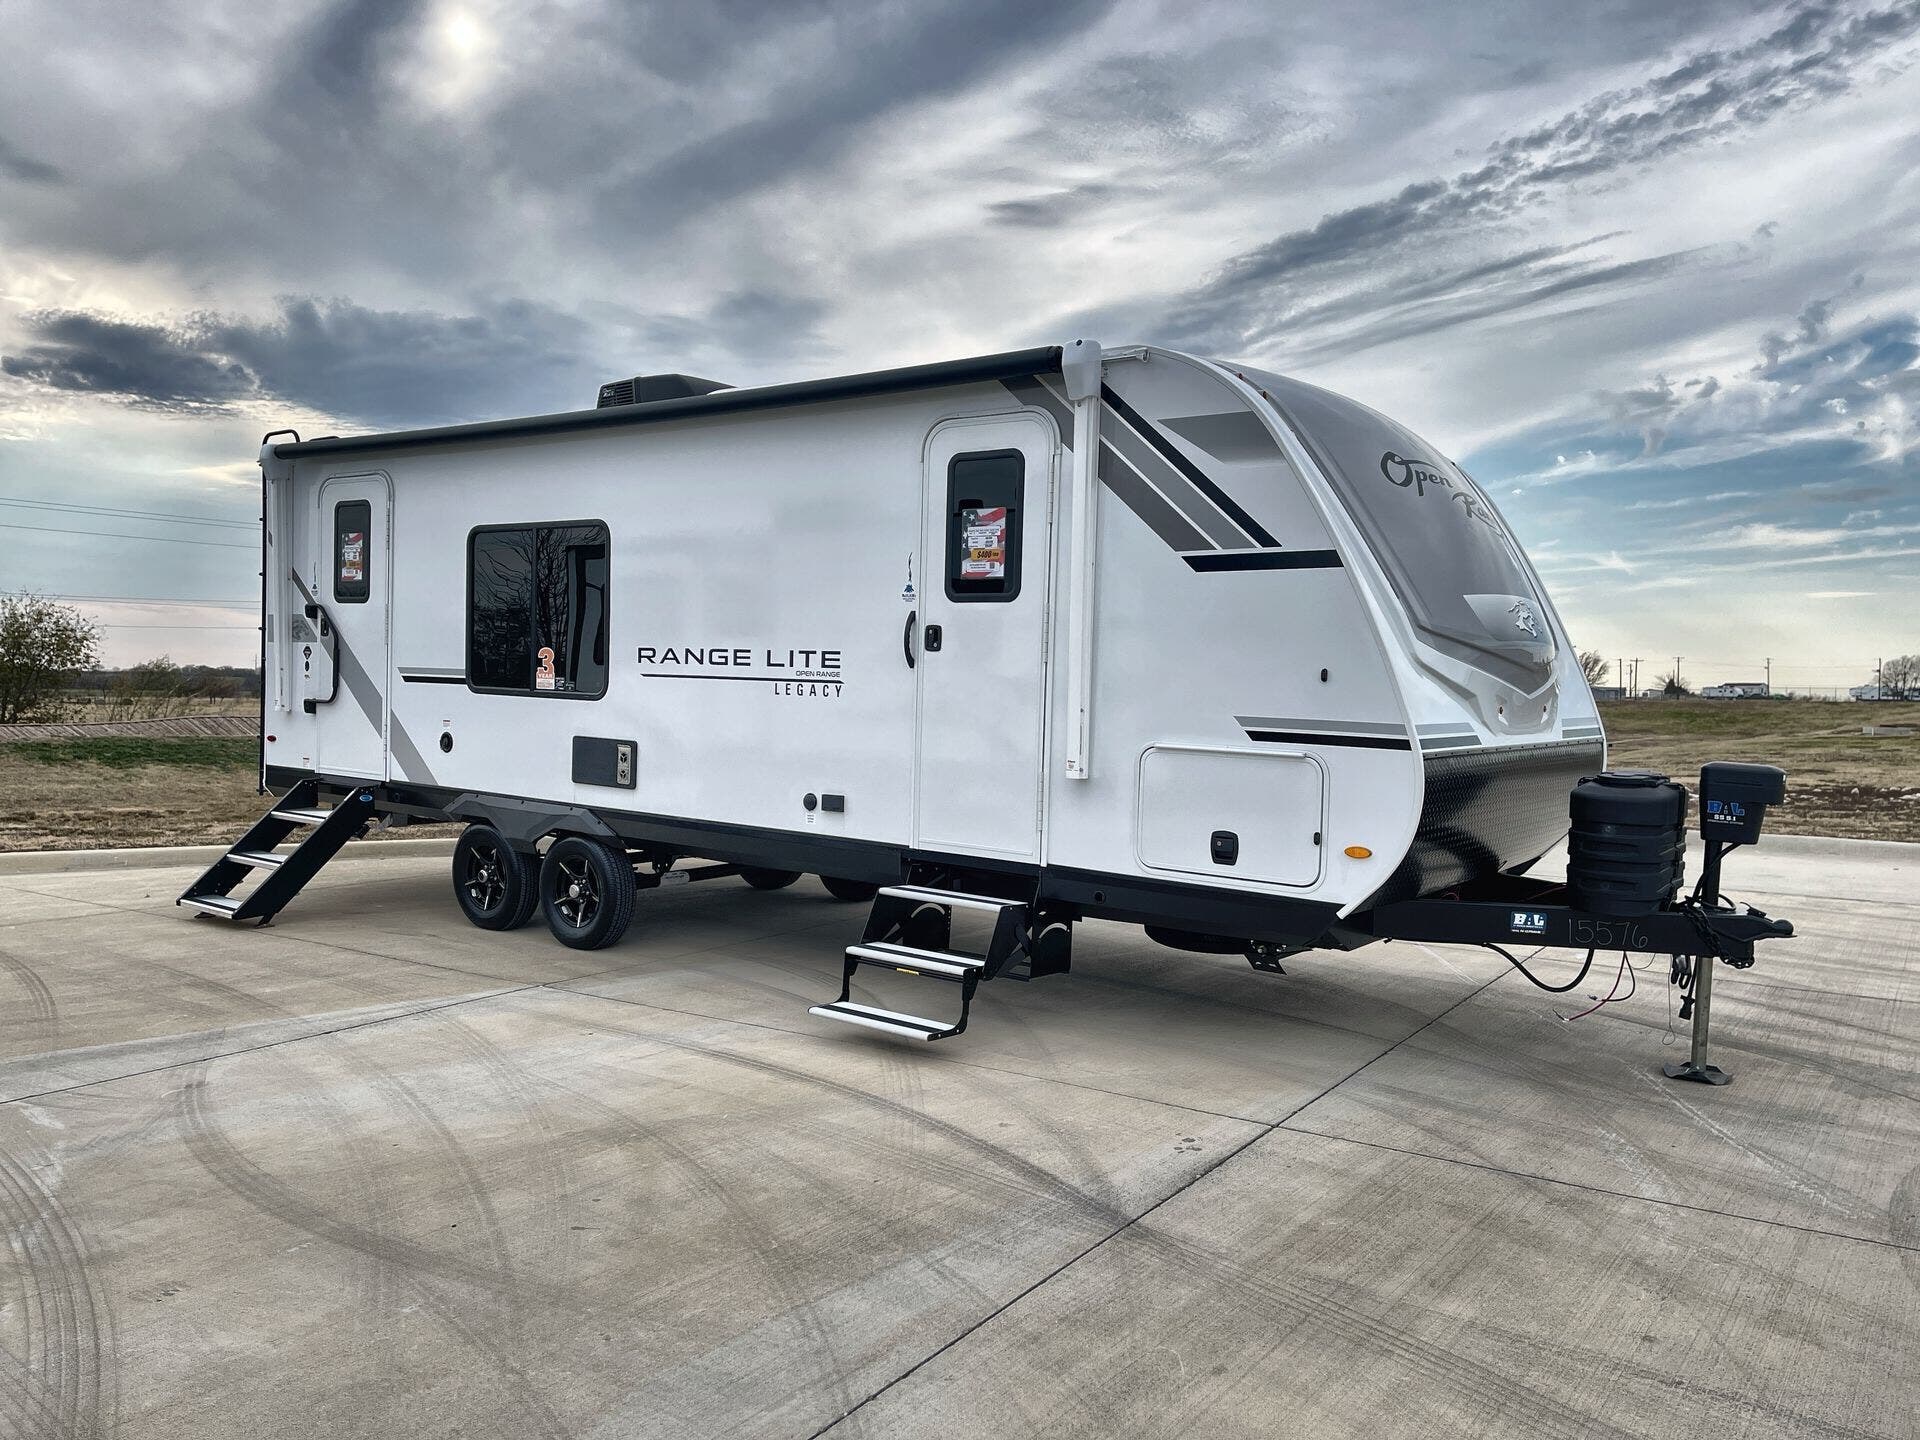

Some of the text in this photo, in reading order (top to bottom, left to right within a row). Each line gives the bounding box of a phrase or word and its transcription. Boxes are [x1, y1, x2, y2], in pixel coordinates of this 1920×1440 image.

[1380, 451, 1454, 496] Open
[538, 647, 555, 673] 3
[637, 647, 841, 669] RANGE LITE
[774, 682, 842, 698] LEGACY
[1567, 917, 1649, 949] 15576
